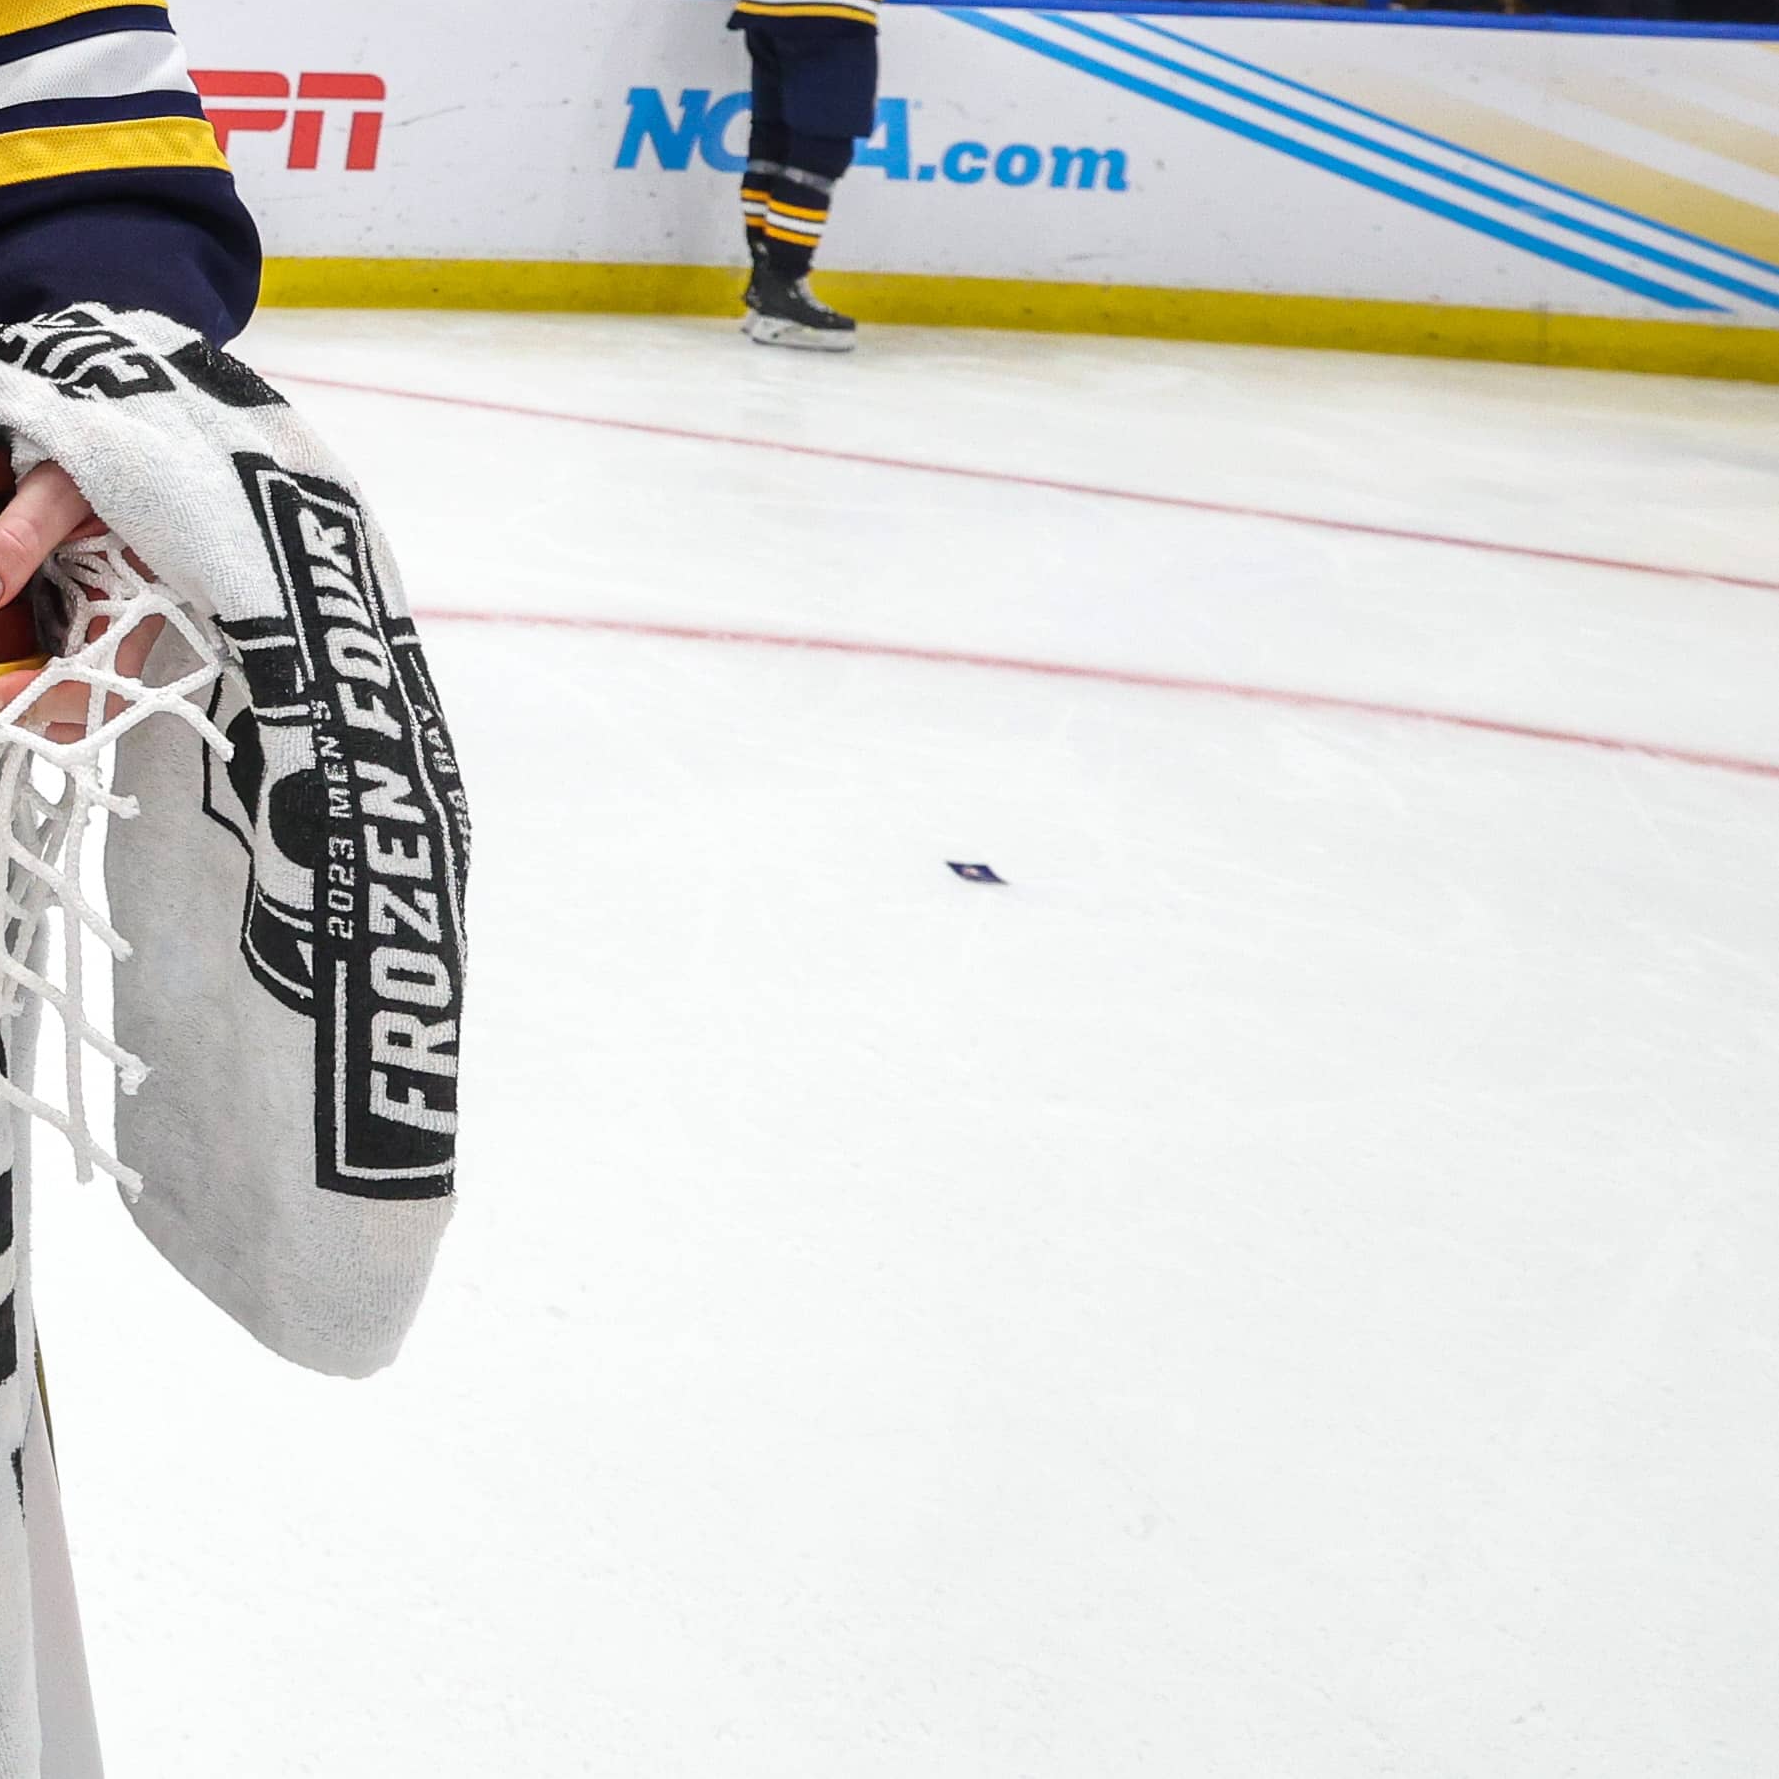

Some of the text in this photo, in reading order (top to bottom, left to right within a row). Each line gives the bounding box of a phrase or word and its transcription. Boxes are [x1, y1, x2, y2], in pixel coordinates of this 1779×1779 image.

[297, 504, 459, 1134] FROZEN FOUR
[309, 700, 356, 941] 2023 MEN'S
